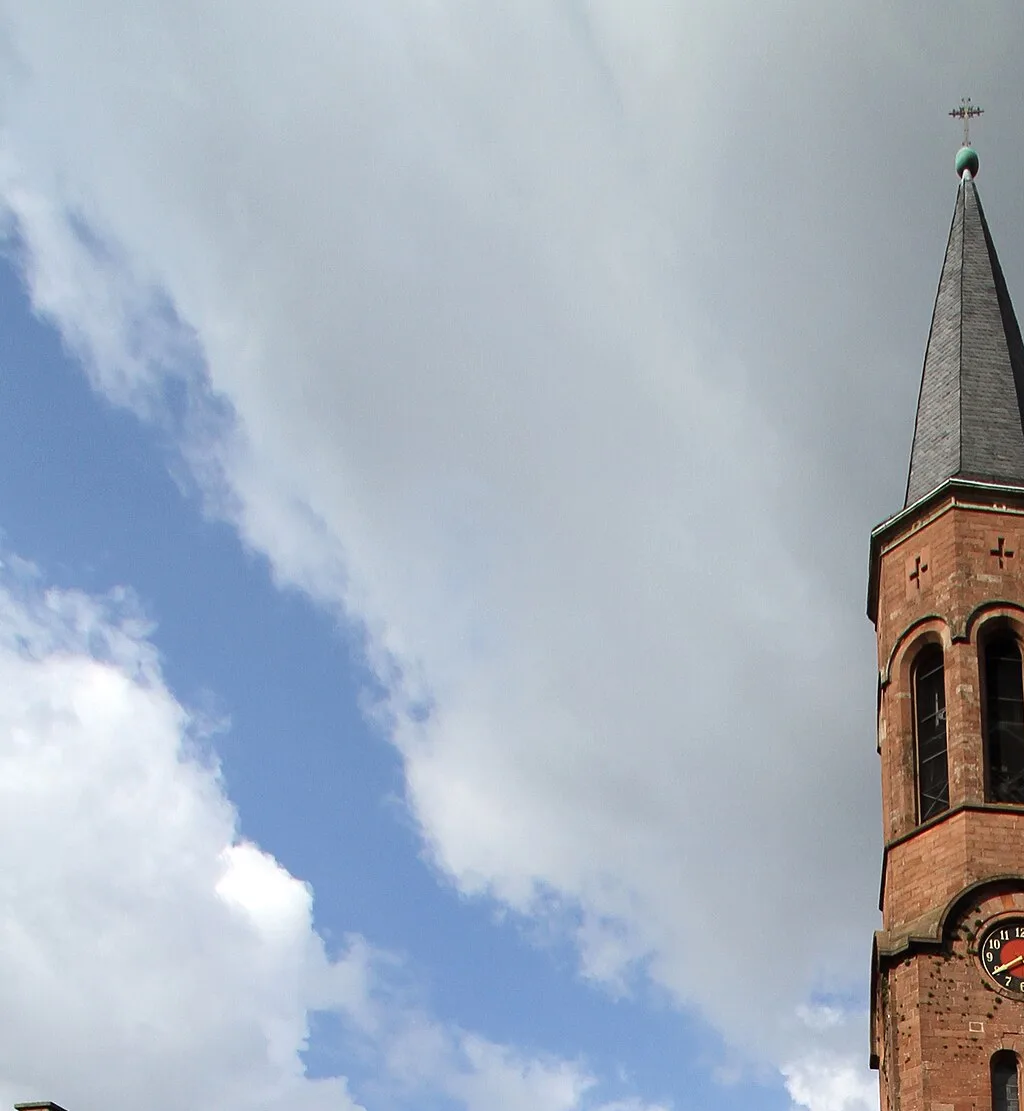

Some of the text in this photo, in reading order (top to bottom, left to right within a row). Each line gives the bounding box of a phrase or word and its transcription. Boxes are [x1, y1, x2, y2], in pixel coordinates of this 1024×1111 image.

[1000, 930, 1009, 940] 11
[989, 939, 1000, 949] 10
[986, 952, 993, 962] 9
[1005, 976, 1012, 986] 7
